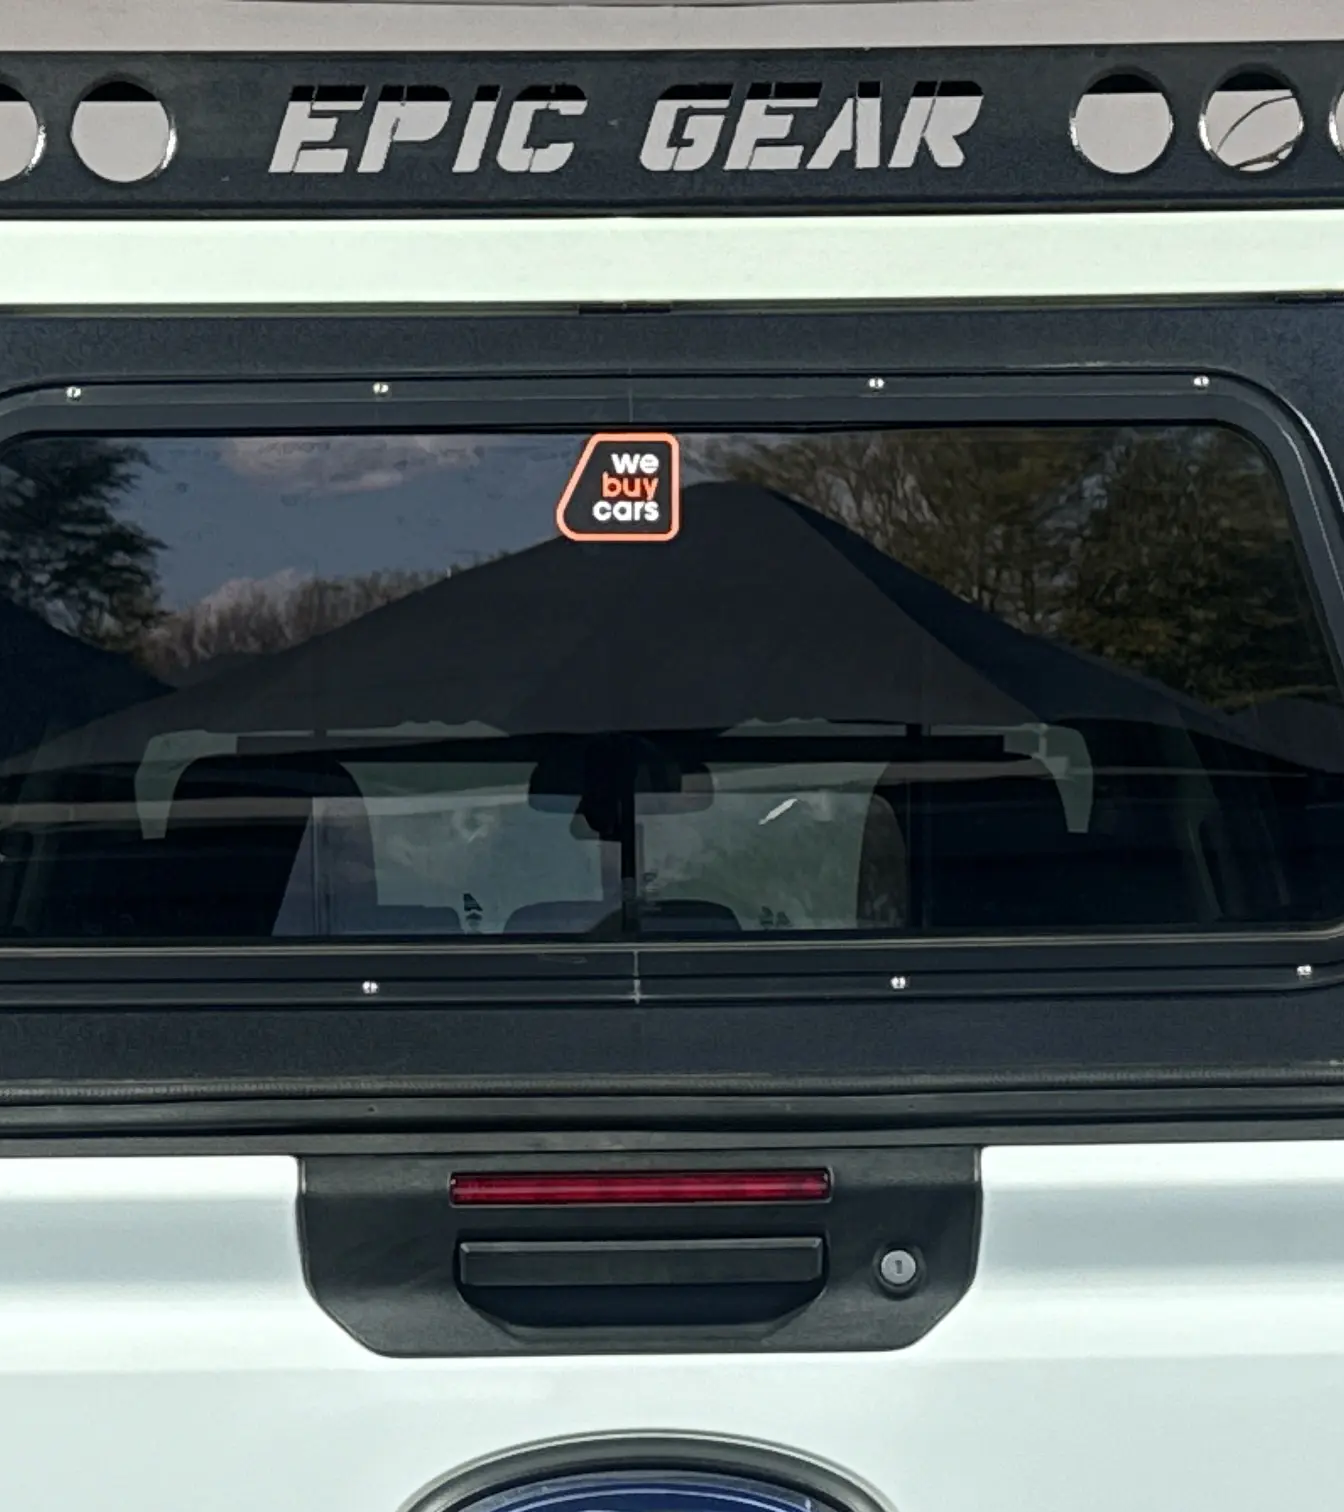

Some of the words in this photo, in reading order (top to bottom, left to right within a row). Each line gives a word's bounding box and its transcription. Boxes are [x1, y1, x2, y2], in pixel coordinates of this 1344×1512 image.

[268, 84, 588, 173] EPIC
[639, 80, 984, 171] GEAR
[611, 453, 659, 474] we
[602, 471, 659, 501] buy
[592, 500, 659, 522] cars
